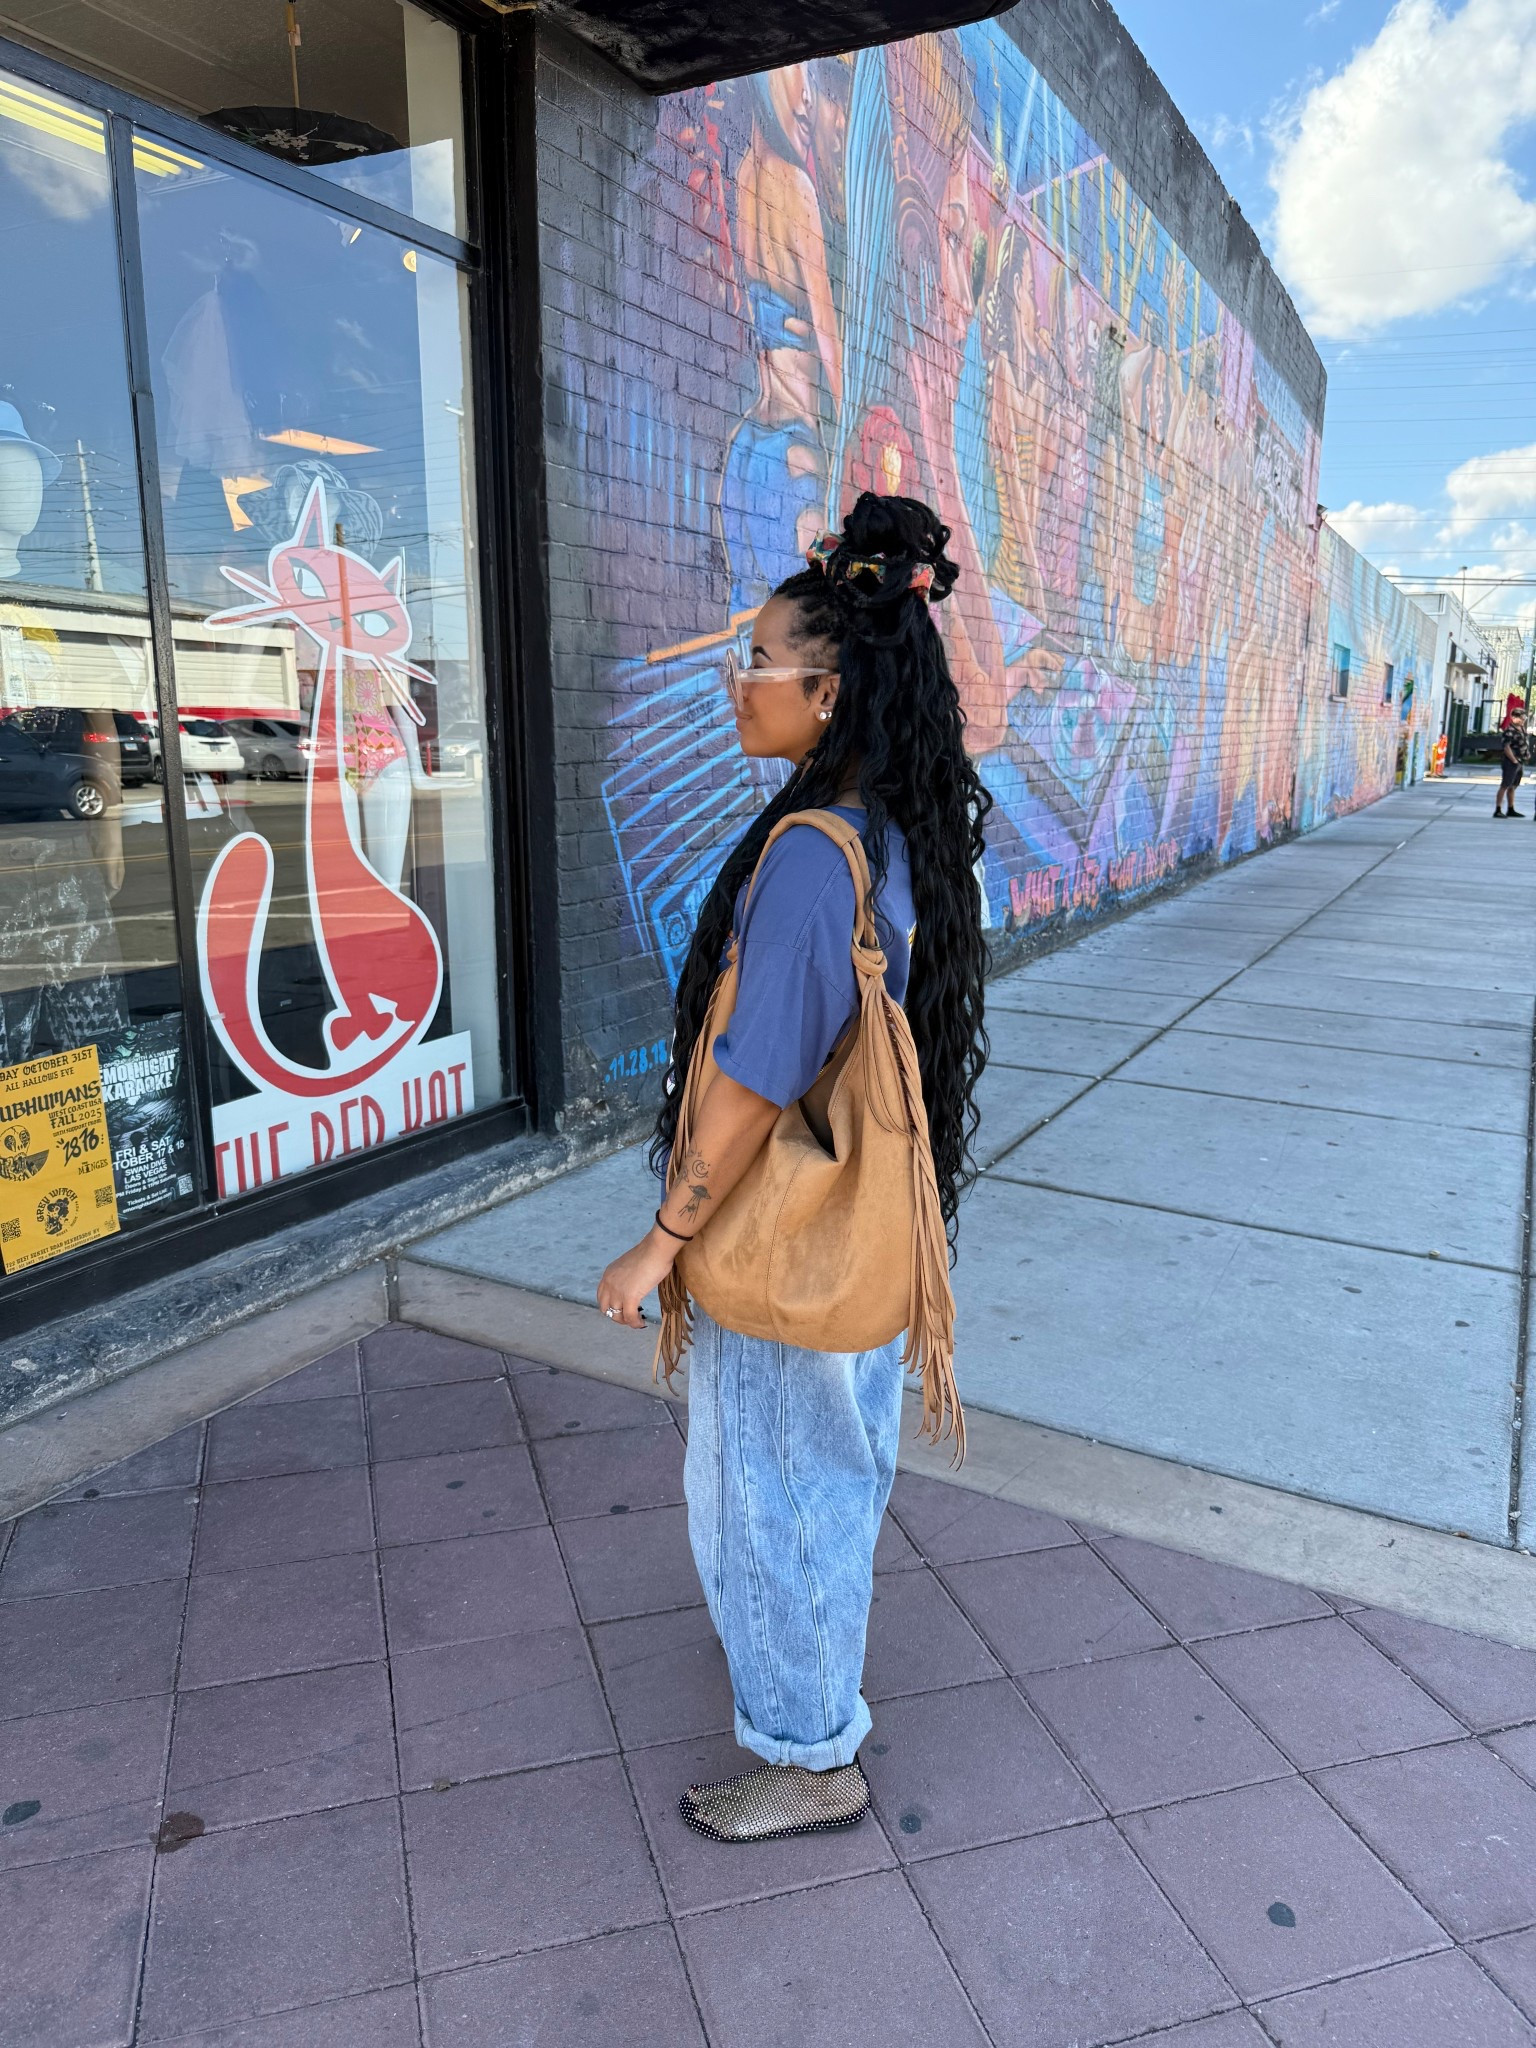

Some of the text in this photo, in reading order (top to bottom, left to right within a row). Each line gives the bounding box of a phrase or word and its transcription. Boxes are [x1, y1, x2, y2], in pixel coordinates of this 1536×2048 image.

[1010, 865, 1062, 917] WHAT
[23, 1055, 68, 1075] OCTOBER
[71, 1049, 93, 1062] 31ST
[6, 1082, 20, 1092] ALL
[23, 1071, 59, 1088] HALLOWS
[102, 1071, 173, 1103] KARAOKE
[49, 1098, 102, 1120] WEST COAST USA
[50, 1108, 102, 1129] FALL 2025
[113, 1152, 154, 1171] TOBER
[156, 1148, 166, 1158] 17
[168, 1145, 174, 1154] &
[116, 1136, 170, 1161] FRI & SAT
[124, 1173, 141, 1184] LAS
[143, 1164, 168, 1178] VEGAS
[125, 1158, 166, 1176] SWAN DIVE
